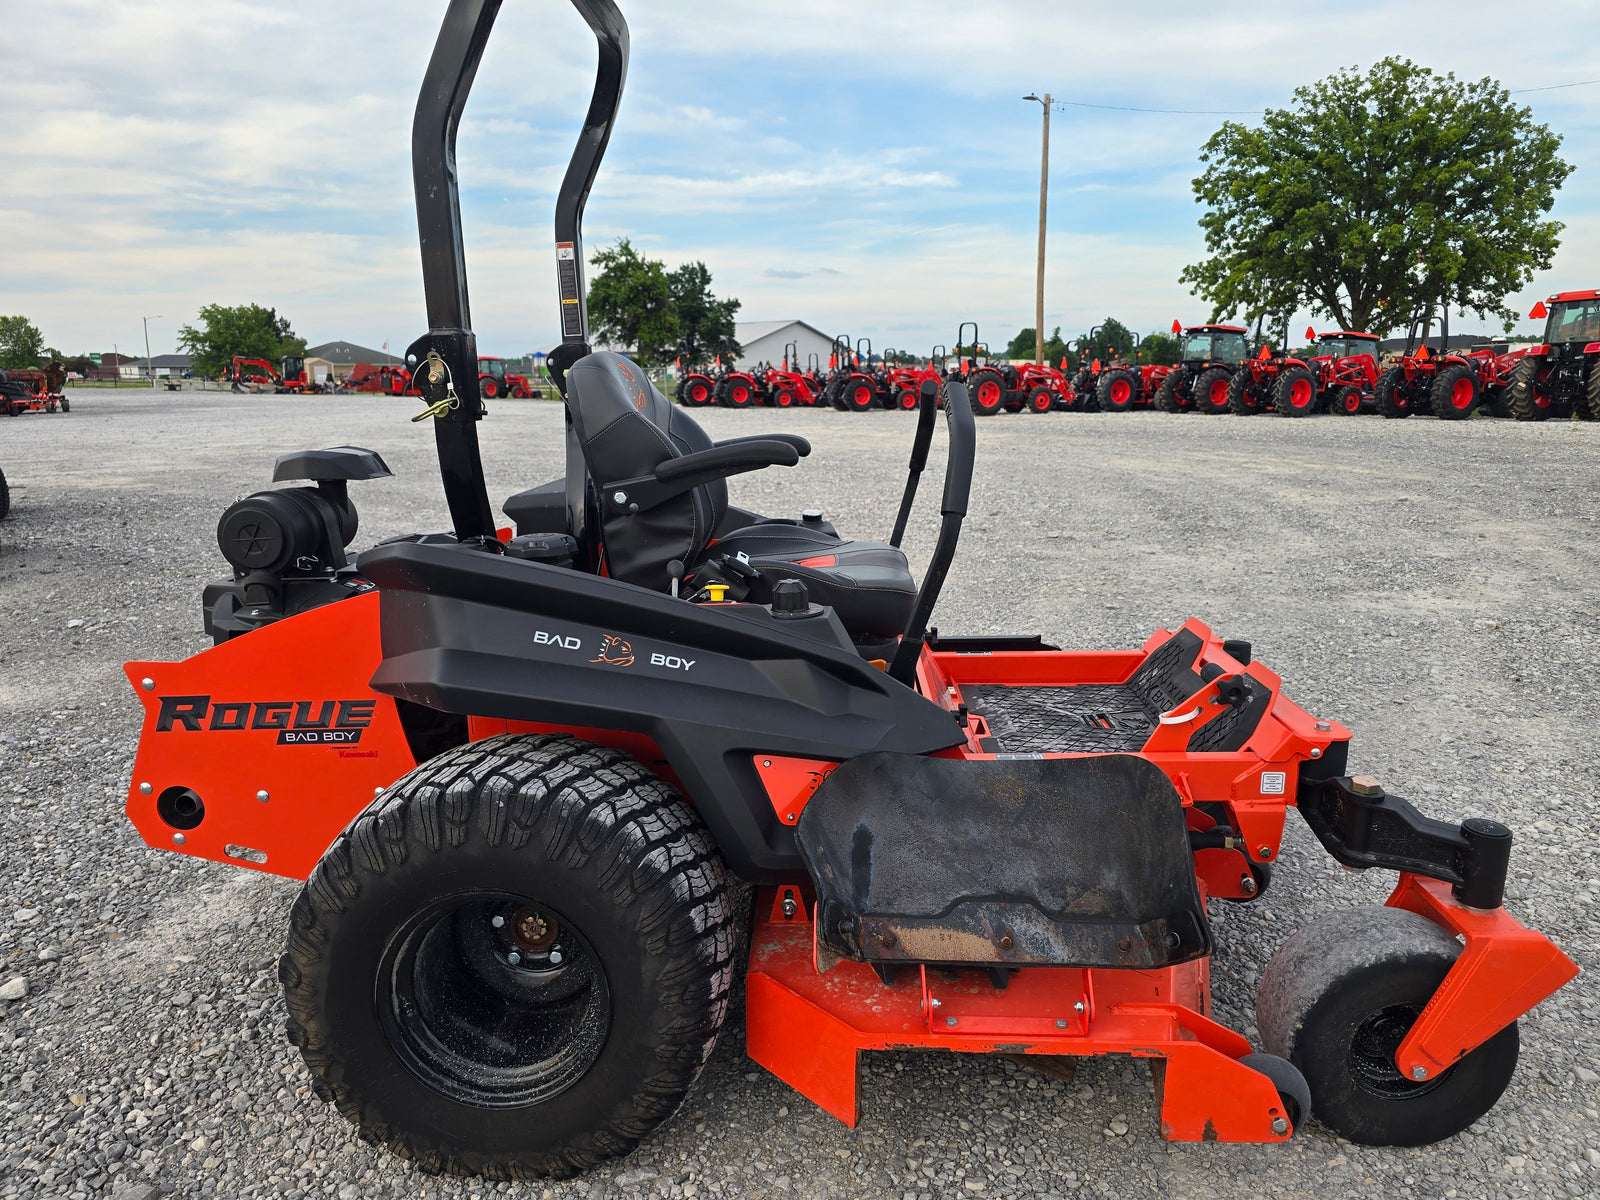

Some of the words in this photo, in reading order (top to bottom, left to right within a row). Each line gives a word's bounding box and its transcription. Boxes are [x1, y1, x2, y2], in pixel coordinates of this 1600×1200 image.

[533, 631, 582, 650] BAD
[650, 652, 696, 671] BOY
[155, 695, 377, 732] ROGUE
[285, 731, 319, 742] BAD
[323, 731, 356, 741] BOY
[338, 750, 378, 758] Kawasaki
